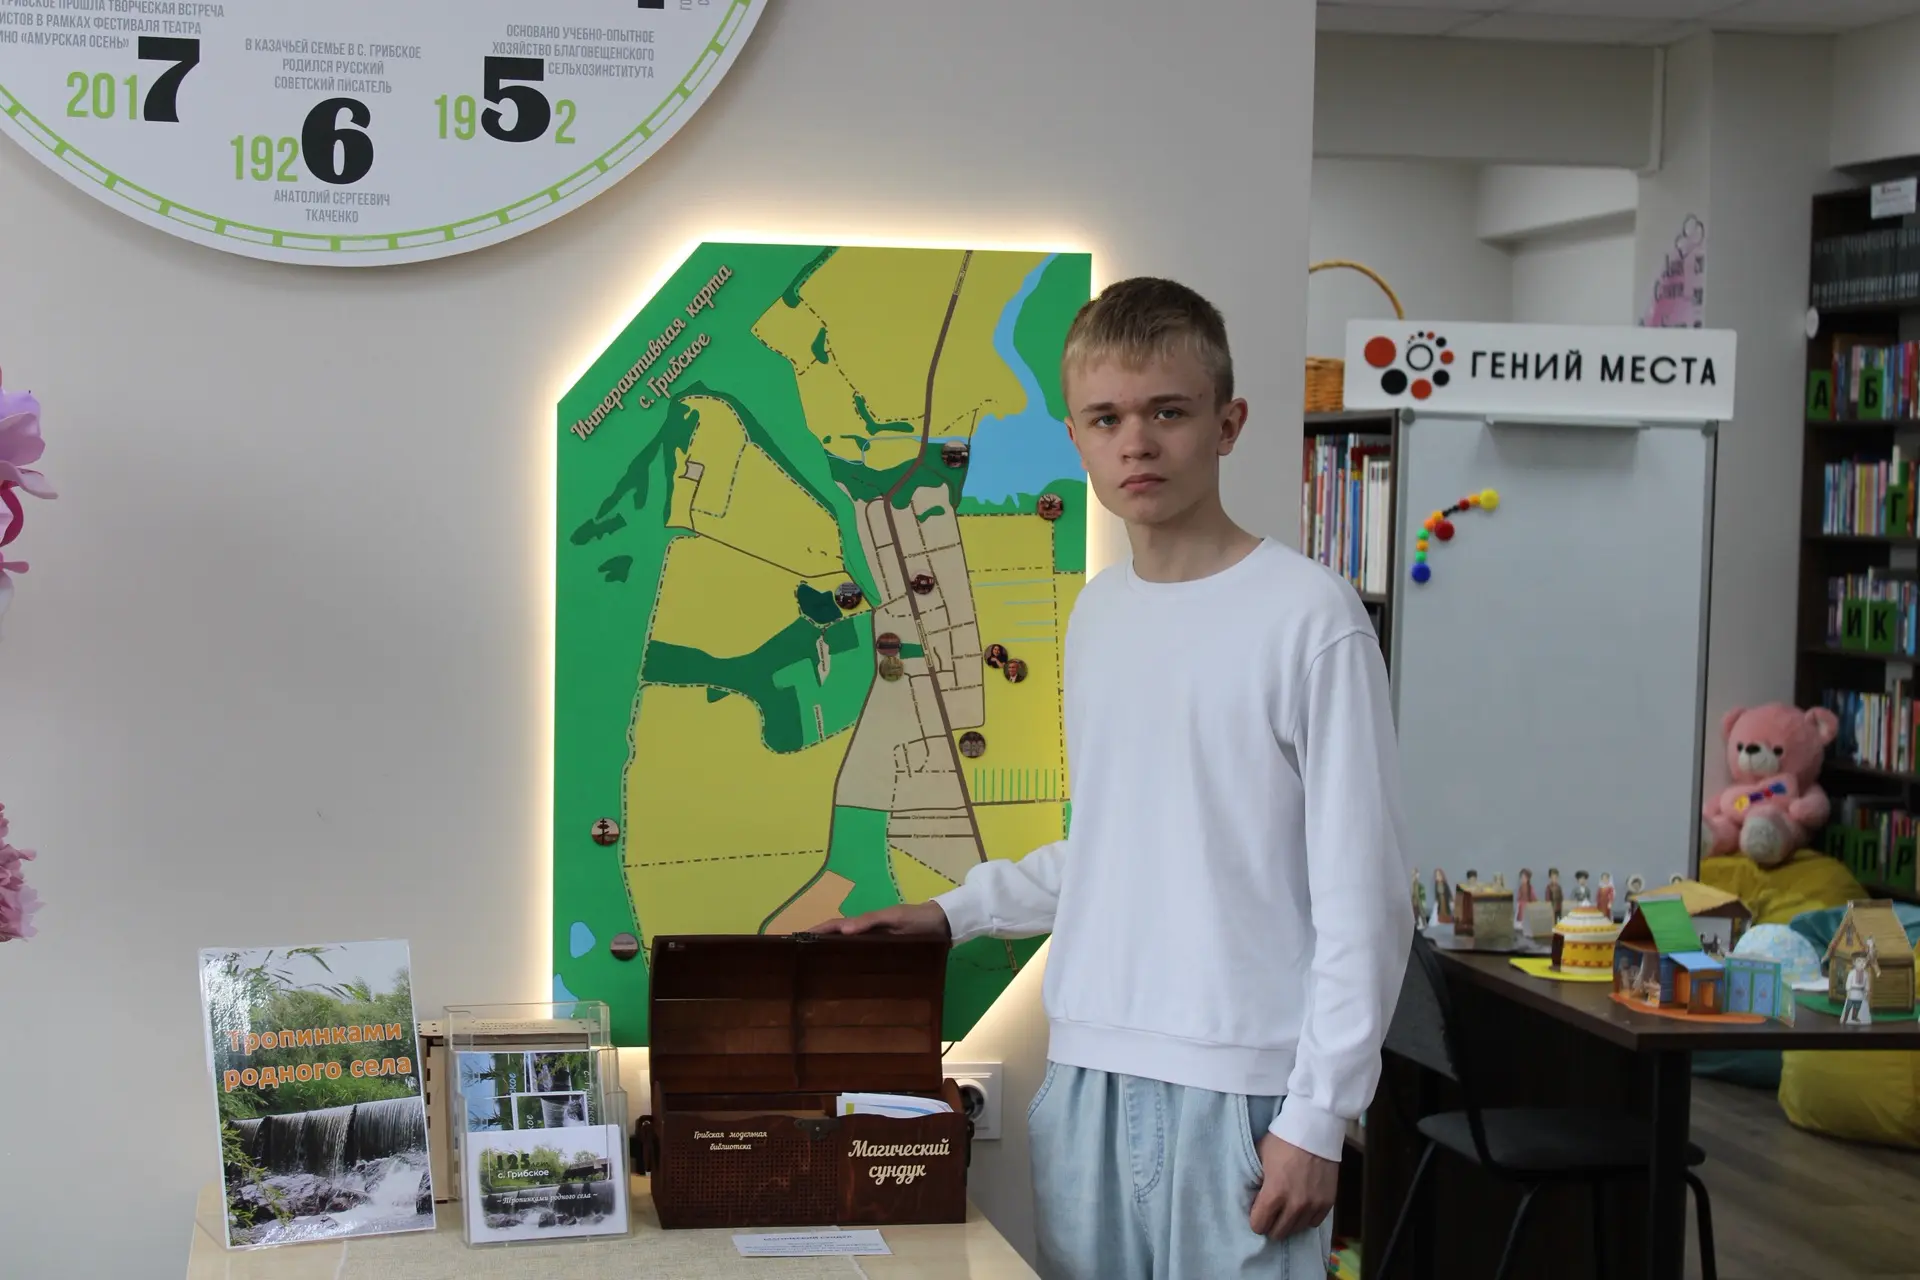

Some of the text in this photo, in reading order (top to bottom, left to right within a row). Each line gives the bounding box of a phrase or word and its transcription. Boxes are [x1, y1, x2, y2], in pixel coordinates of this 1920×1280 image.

[108, 0, 176, 15] ТВОРЧЕСКАЯ
[177, 3, 225, 17] ВСТРЕЧА
[36, 14, 44, 26] В
[46, 15, 91, 29] РАМКАХ
[93, 17, 160, 32] ФЕСТИВАЛЯ
[162, 20, 202, 34] ТЕАТРА
[506, 24, 655, 43] ОСНОВАНО УЧЕБНО-ОПЫТНОЕ
[21, 31, 87, 47] «АМУРСКАЯ
[89, 35, 130, 49] ОСЕНЬ»
[245, 38, 422, 59] В КАЗАЧЬЕЙ СЕМЬЕ В С. ГРИБСКОЕ
[492, 41, 655, 61] ХОЗЯЙСТВО БЛАГОВЕЩЕНСКОГО
[282, 58, 384, 75] РОДИЛСЯ РУССКИЙ
[548, 62, 655, 78] СЕЛЬХОЗИНСТИТУТА
[274, 75, 392, 94] СОВЕТСКИЙ ПИСАТЕЛЬ
[274, 189, 390, 206] АНАТОЛИЙ СЕРГЕЕВИЧ
[305, 208, 359, 224] ТКАЧЕНКО
[570, 264, 733, 441] Интерактивная карта
[639, 333, 711, 409] с. Грибское
[1471, 349, 1717, 386] ГЕНИЙ МЕСТА
[1813, 378, 1829, 411] А
[1864, 376, 1879, 410] Б
[1890, 492, 1905, 525] Г
[1872, 609, 1889, 641] К
[225, 1023, 402, 1055] Тропинками
[223, 1056, 412, 1093] родного села
[693, 1130, 768, 1141] Грибская модельная
[709, 1142, 752, 1151] библиотека
[847, 1137, 951, 1157] Магический
[496, 1153, 531, 1171] 125
[497, 1169, 549, 1180] с. Грибское
[868, 1164, 927, 1186] сундук
